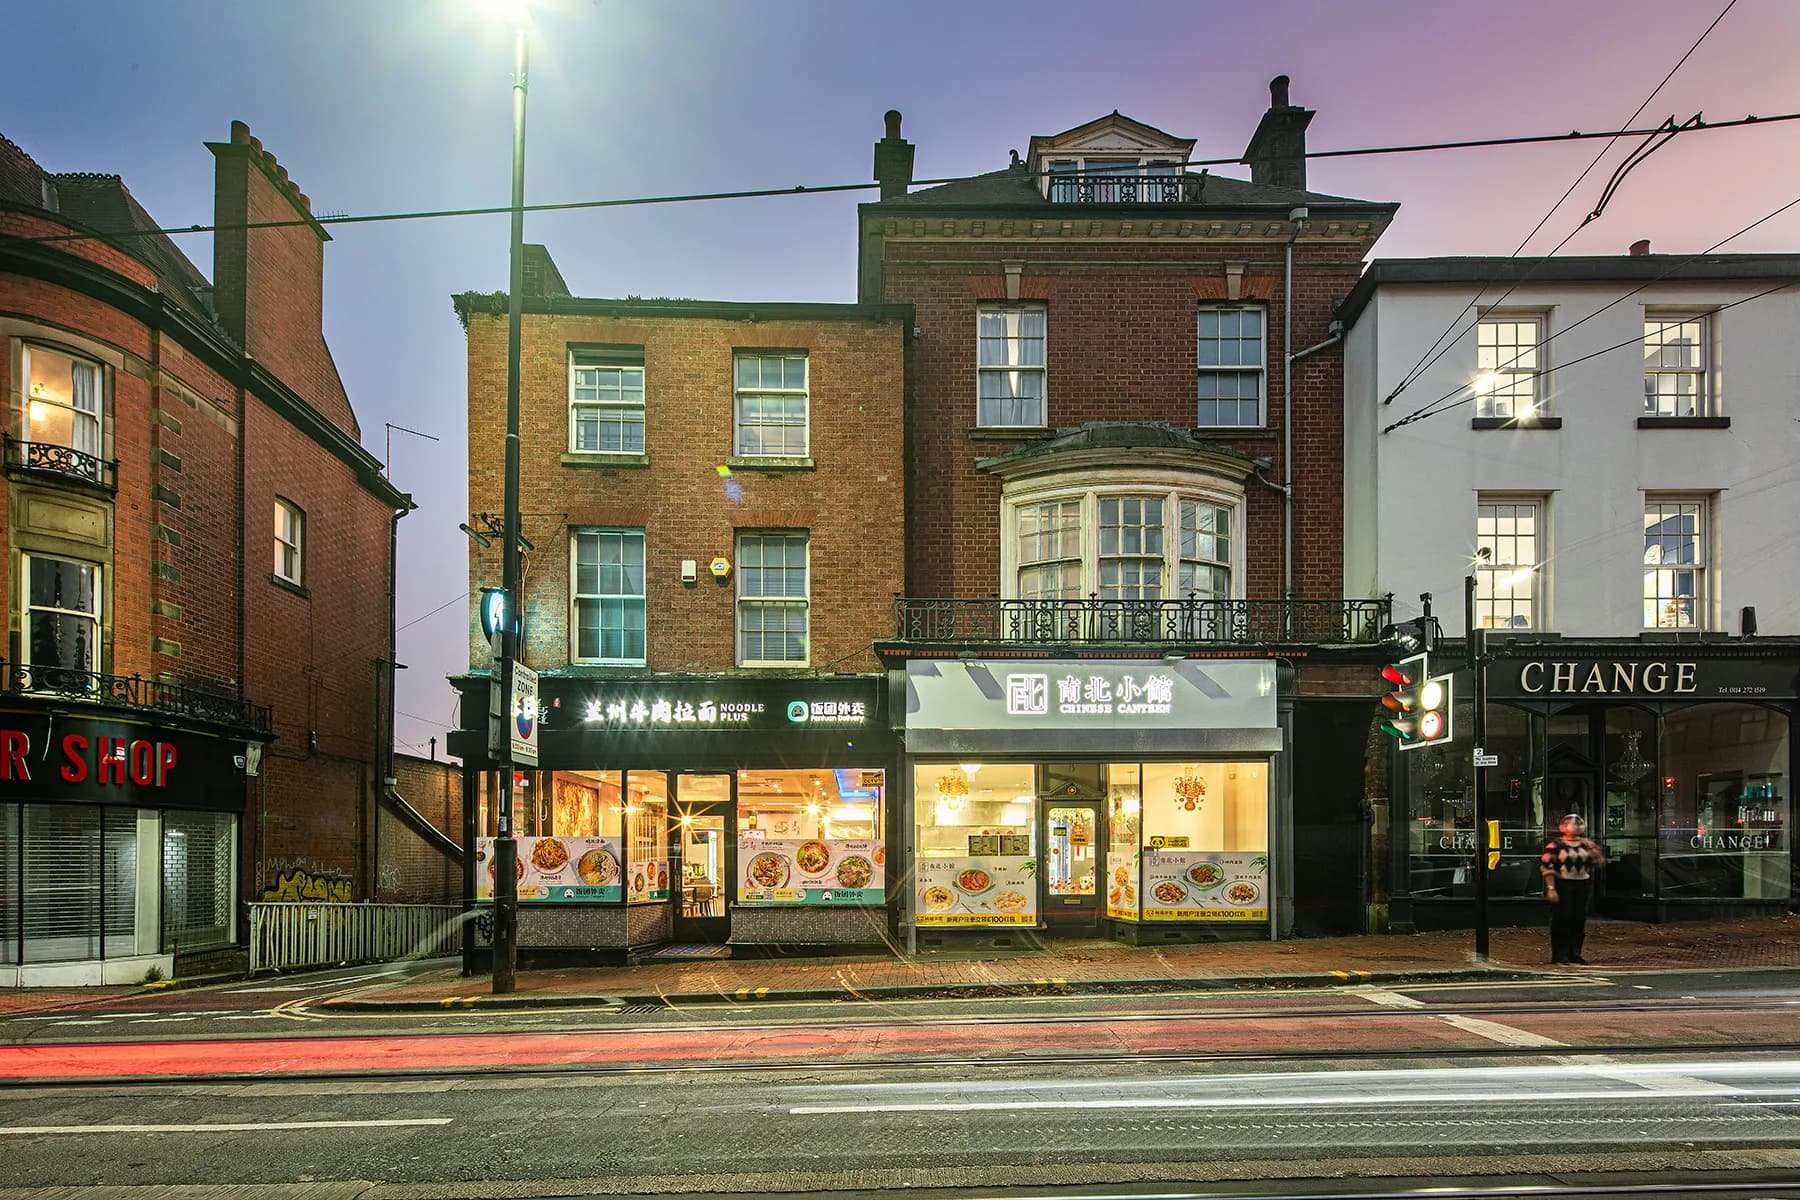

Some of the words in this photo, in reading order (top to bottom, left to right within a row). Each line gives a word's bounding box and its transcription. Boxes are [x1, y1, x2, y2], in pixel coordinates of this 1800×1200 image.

[514, 665, 537, 685] Controlled
[1520, 662, 1697, 693] CHANGE
[517, 680, 533, 696] ZONE
[720, 703, 764, 713] NOODLE
[811, 702, 864, 715] 饭团外卖
[1059, 704, 1112, 714] CHINESE
[1117, 704, 1171, 714] CANTEEN
[720, 712, 748, 722] PLUS
[0, 729, 31, 781] R
[60, 734, 178, 787] SHOP
[1440, 836, 1513, 849] CHAE
[1690, 836, 1764, 849] CHANGE
